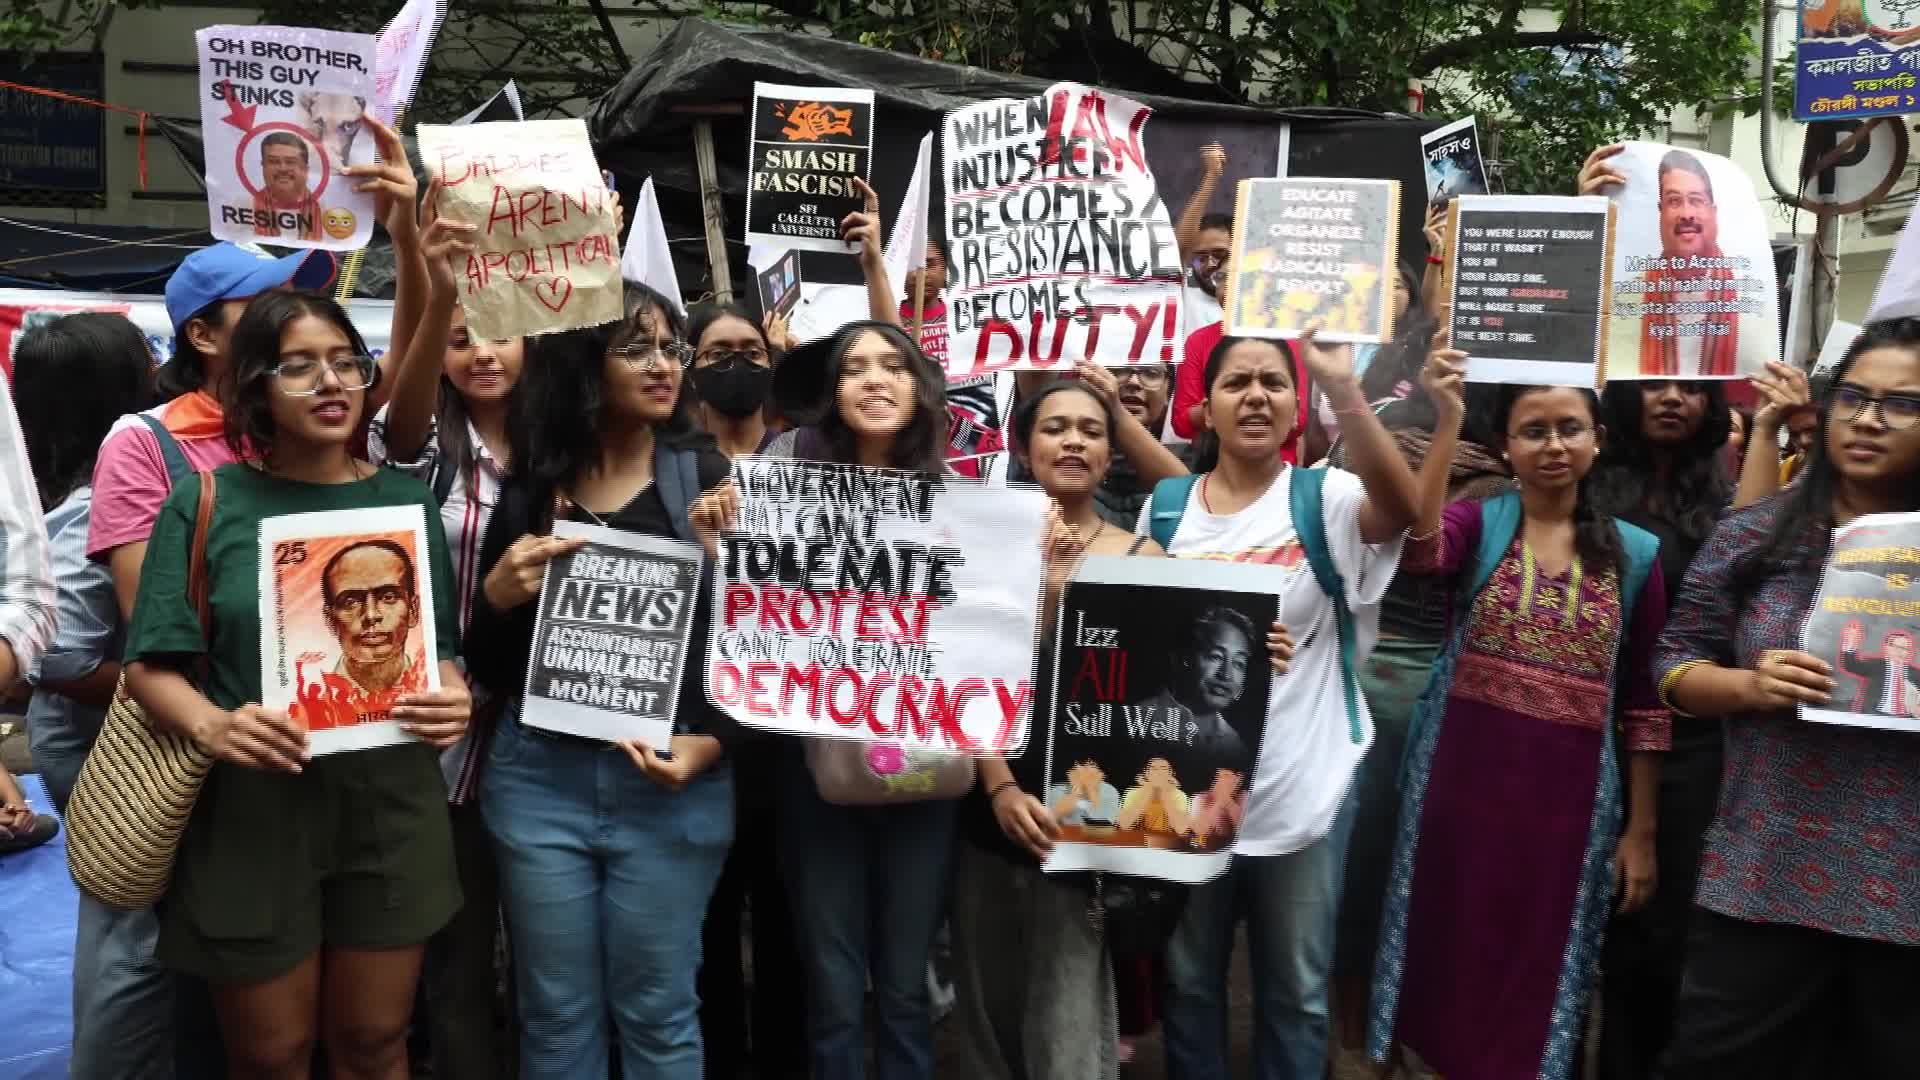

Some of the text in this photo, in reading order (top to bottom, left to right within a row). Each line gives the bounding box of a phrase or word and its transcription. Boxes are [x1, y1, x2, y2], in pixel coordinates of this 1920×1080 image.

[208, 38, 368, 75] OH BROTHER,
[209, 58, 320, 86] THIS GUY
[211, 82, 295, 108] STINKS
[953, 90, 1153, 174] WHEN LAW
[765, 150, 856, 173] SMASH
[952, 136, 1112, 194] INJUSTICE
[1280, 188, 1359, 203] EDUCATE
[222, 205, 314, 233] RESIGN
[777, 212, 836, 228] CALCUTTA
[799, 203, 819, 215] SFI
[952, 182, 1134, 238] BECOMES
[1279, 206, 1353, 221] AGITATE
[771, 223, 837, 239] UNIVERSITY
[1269, 224, 1364, 240] ORGANIZE
[1463, 228, 1595, 241] YOU WERE LUCKY ENOUGH
[963, 217, 1183, 290] RESISTANCE
[1285, 241, 1344, 256] RESIST
[1463, 243, 1489, 253] THAT
[1491, 243, 1502, 253] IT
[1462, 257, 1482, 267] YOU
[1624, 255, 1667, 272] Maine
[1671, 256, 1687, 270] to
[1460, 272, 1487, 283] YOUR
[1488, 272, 1521, 283] LOVED
[1658, 277, 1672, 292] hi
[1673, 278, 1707, 292] nahi
[1708, 279, 1724, 291] to
[1458, 286, 1480, 297] BUT
[1482, 286, 1509, 298] YOUR
[954, 279, 1093, 334] BECOMES
[1457, 302, 1546, 314] WILL MAKE SURE
[1640, 301, 1664, 317] pta
[1456, 316, 1468, 326] IT
[1469, 316, 1481, 327] IS
[1648, 319, 1730, 341] kya hoti hai
[968, 296, 1178, 374] DUTY!
[1456, 331, 1476, 341] THE
[1477, 331, 1505, 343] NEXT
[749, 462, 948, 522] GOVERNMENT
[275, 541, 309, 566] 25
[569, 553, 680, 588] BREAKING
[721, 535, 965, 604] TOLERATE
[556, 580, 680, 626] NEWS
[723, 583, 942, 646] PROTEST
[1074, 609, 1120, 648] Izz
[547, 625, 679, 661] ACCOUNTABILITY
[543, 644, 674, 683] UNAVAILABLE
[808, 634, 944, 680] TOLERATE
[603, 675, 623, 688] THE
[1072, 649, 1129, 704] All
[548, 679, 659, 712] MOMENT
[711, 660, 1036, 753] DEMOCRACY
[1064, 702, 1113, 738] Still
